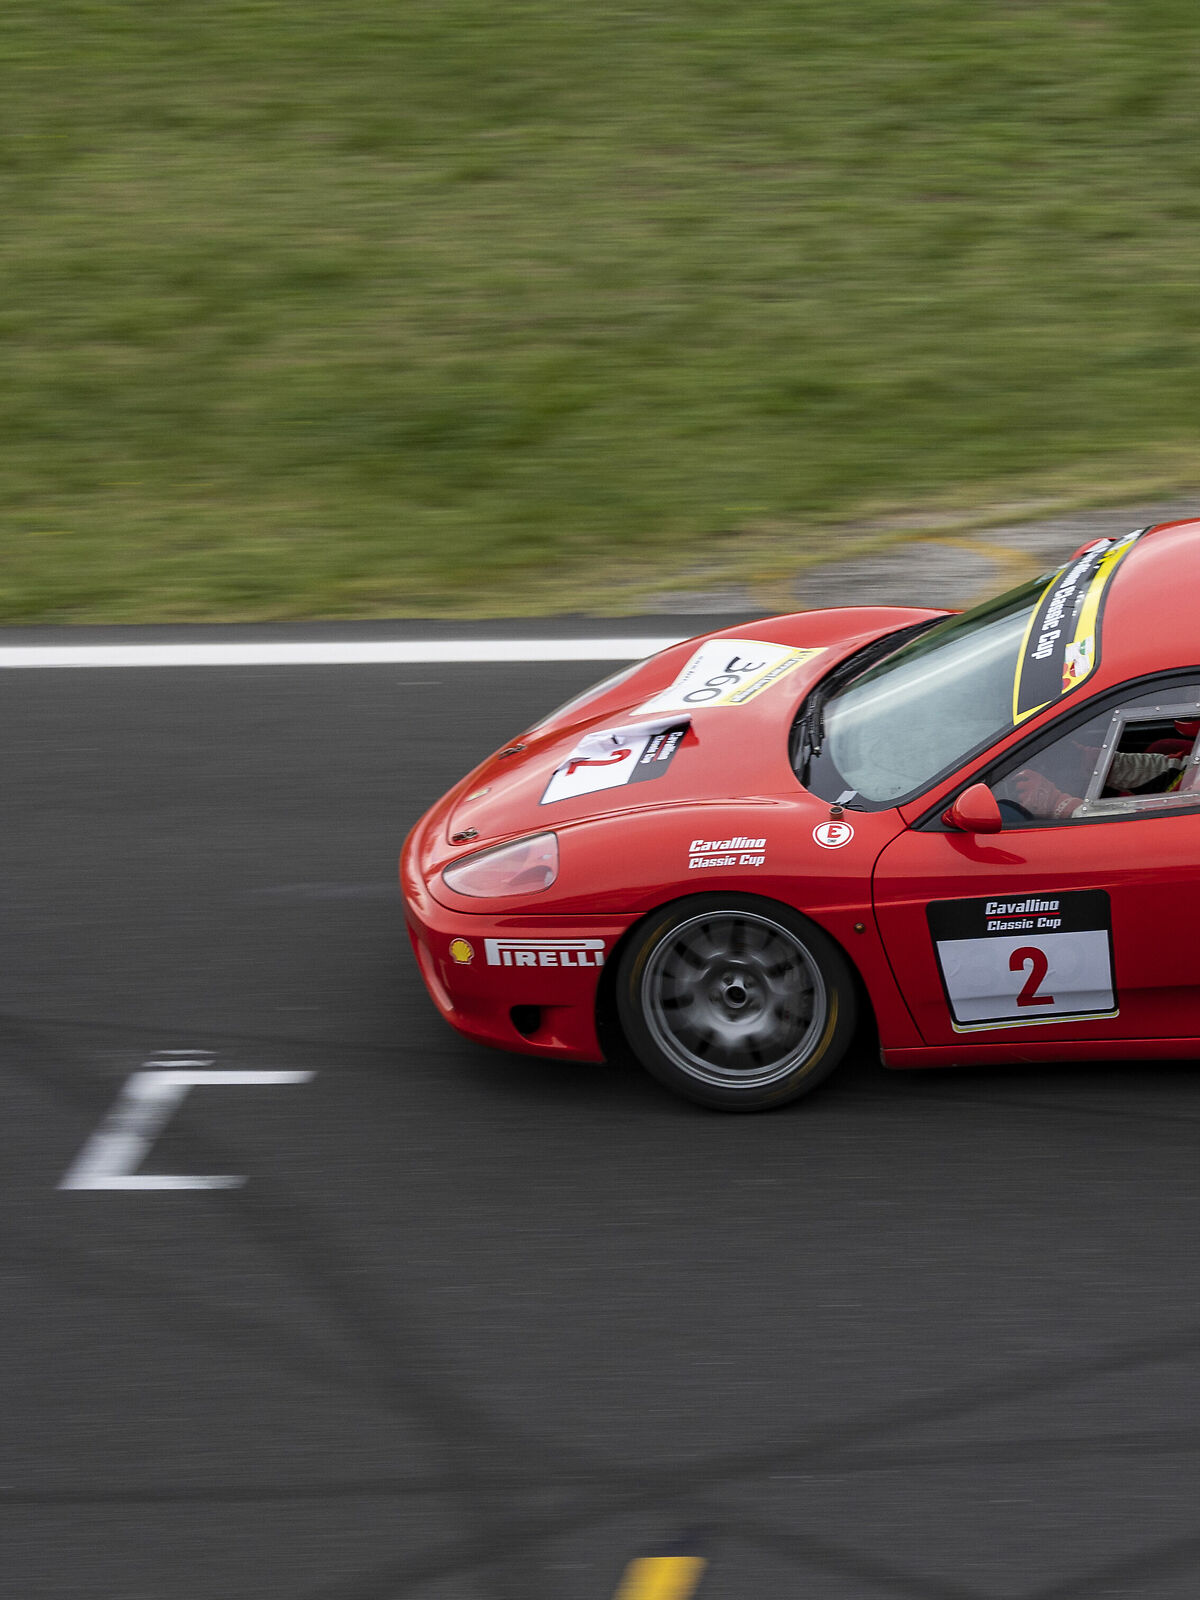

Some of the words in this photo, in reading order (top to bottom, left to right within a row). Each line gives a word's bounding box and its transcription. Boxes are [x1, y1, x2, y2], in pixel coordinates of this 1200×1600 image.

[1030, 629, 1061, 660] Cup
[682, 656, 766, 703] 360
[565, 748, 632, 777] 2
[827, 824, 843, 838] E
[688, 836, 767, 853] Cavallino
[688, 855, 737, 869] Classic
[738, 854, 766, 867] Cup
[984, 899, 1060, 915] Cavallino
[986, 918, 1034, 931] Classic
[1036, 917, 1062, 929] Cup
[483, 938, 606, 967] PIRELLI
[1008, 946, 1055, 1008] 2
